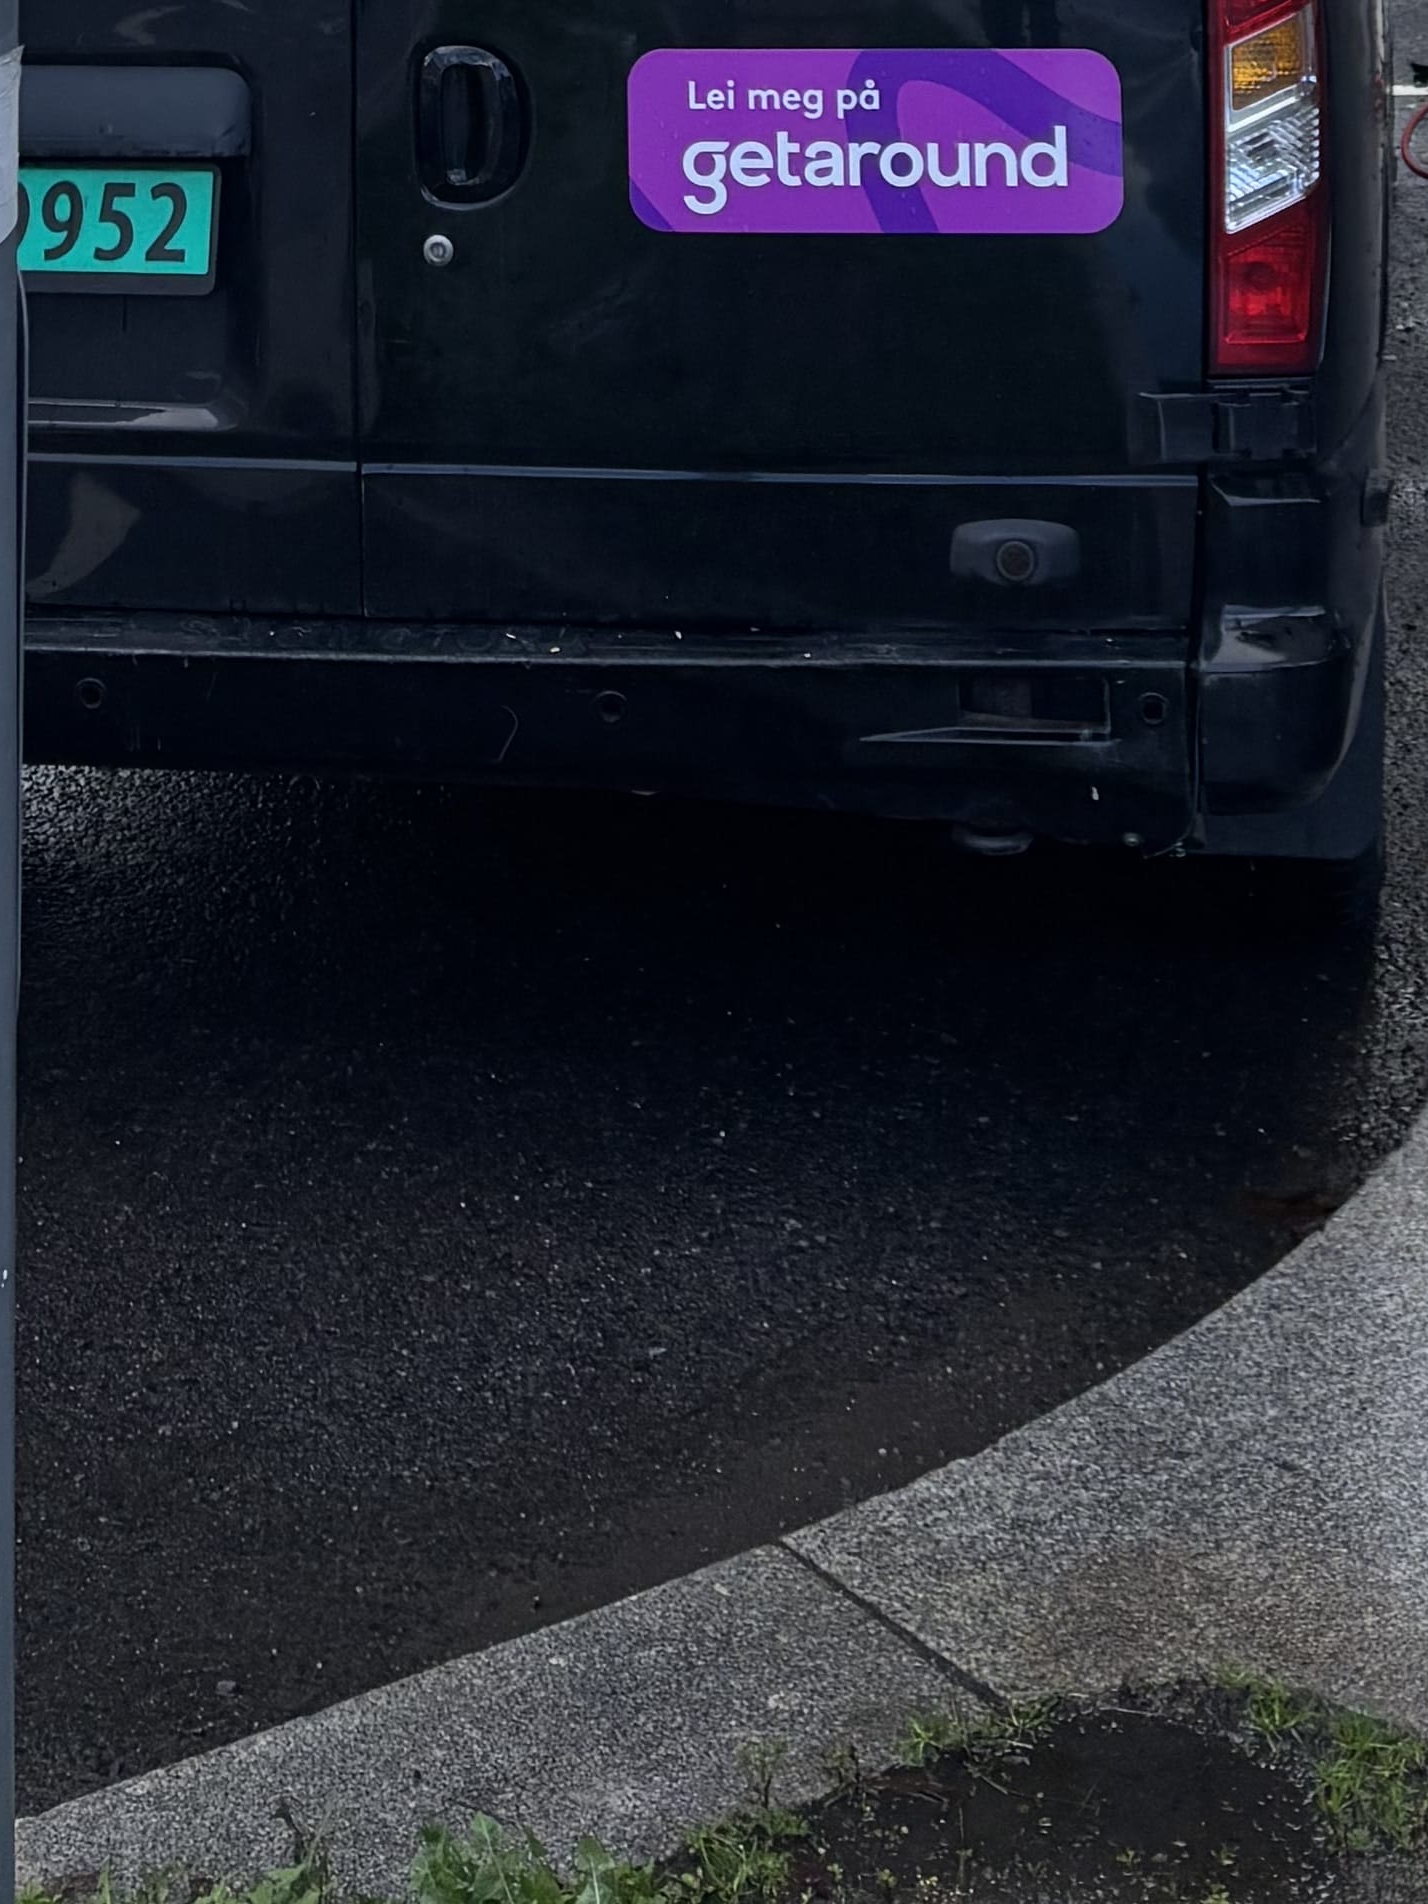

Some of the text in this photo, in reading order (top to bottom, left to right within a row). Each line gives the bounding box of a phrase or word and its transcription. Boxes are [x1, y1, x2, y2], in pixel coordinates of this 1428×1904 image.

[688, 79, 881, 119] Lei meg på
[682, 125, 1069, 214] getaround
[18, 181, 187, 263] 952
